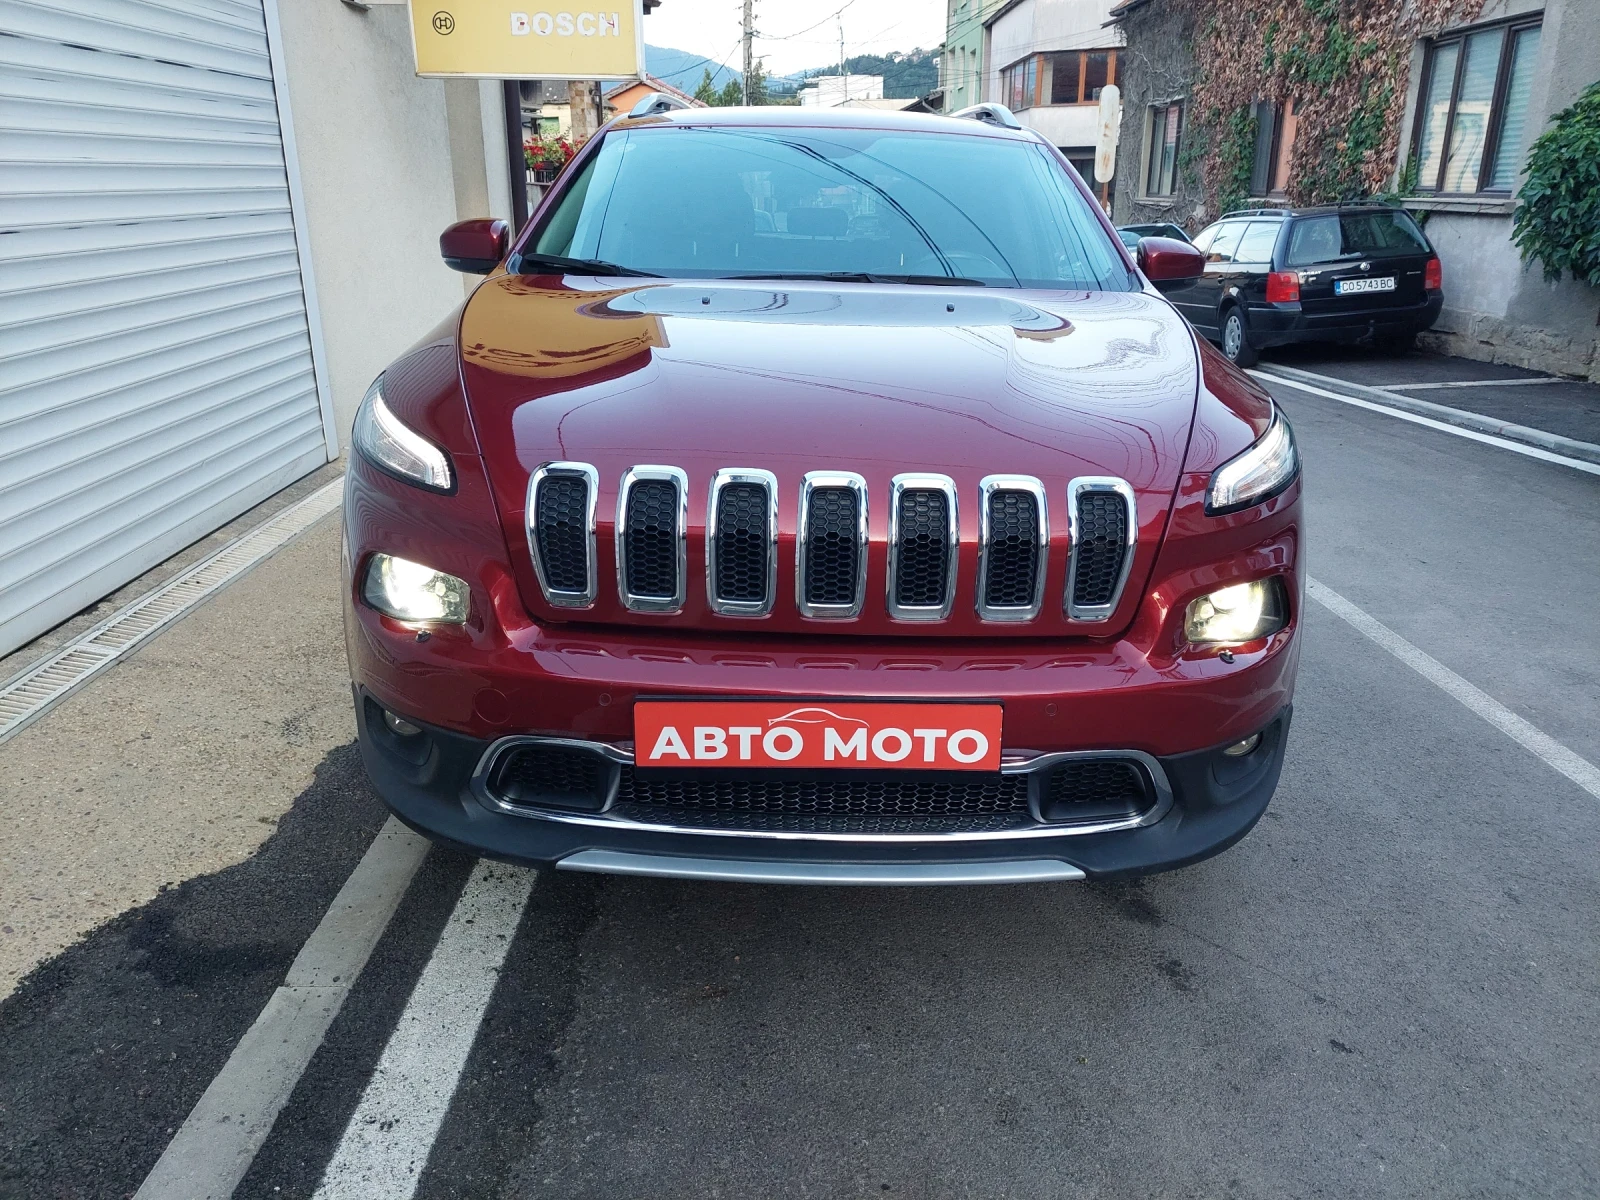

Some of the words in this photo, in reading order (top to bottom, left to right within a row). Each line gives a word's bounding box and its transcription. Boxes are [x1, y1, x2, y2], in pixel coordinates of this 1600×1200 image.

[510, 12, 620, 37] BOSCH
[1356, 280, 1379, 291] 5743
[1380, 279, 1393, 289] BC
[649, 726, 804, 760] АВТО
[824, 727, 989, 763] МОТО
